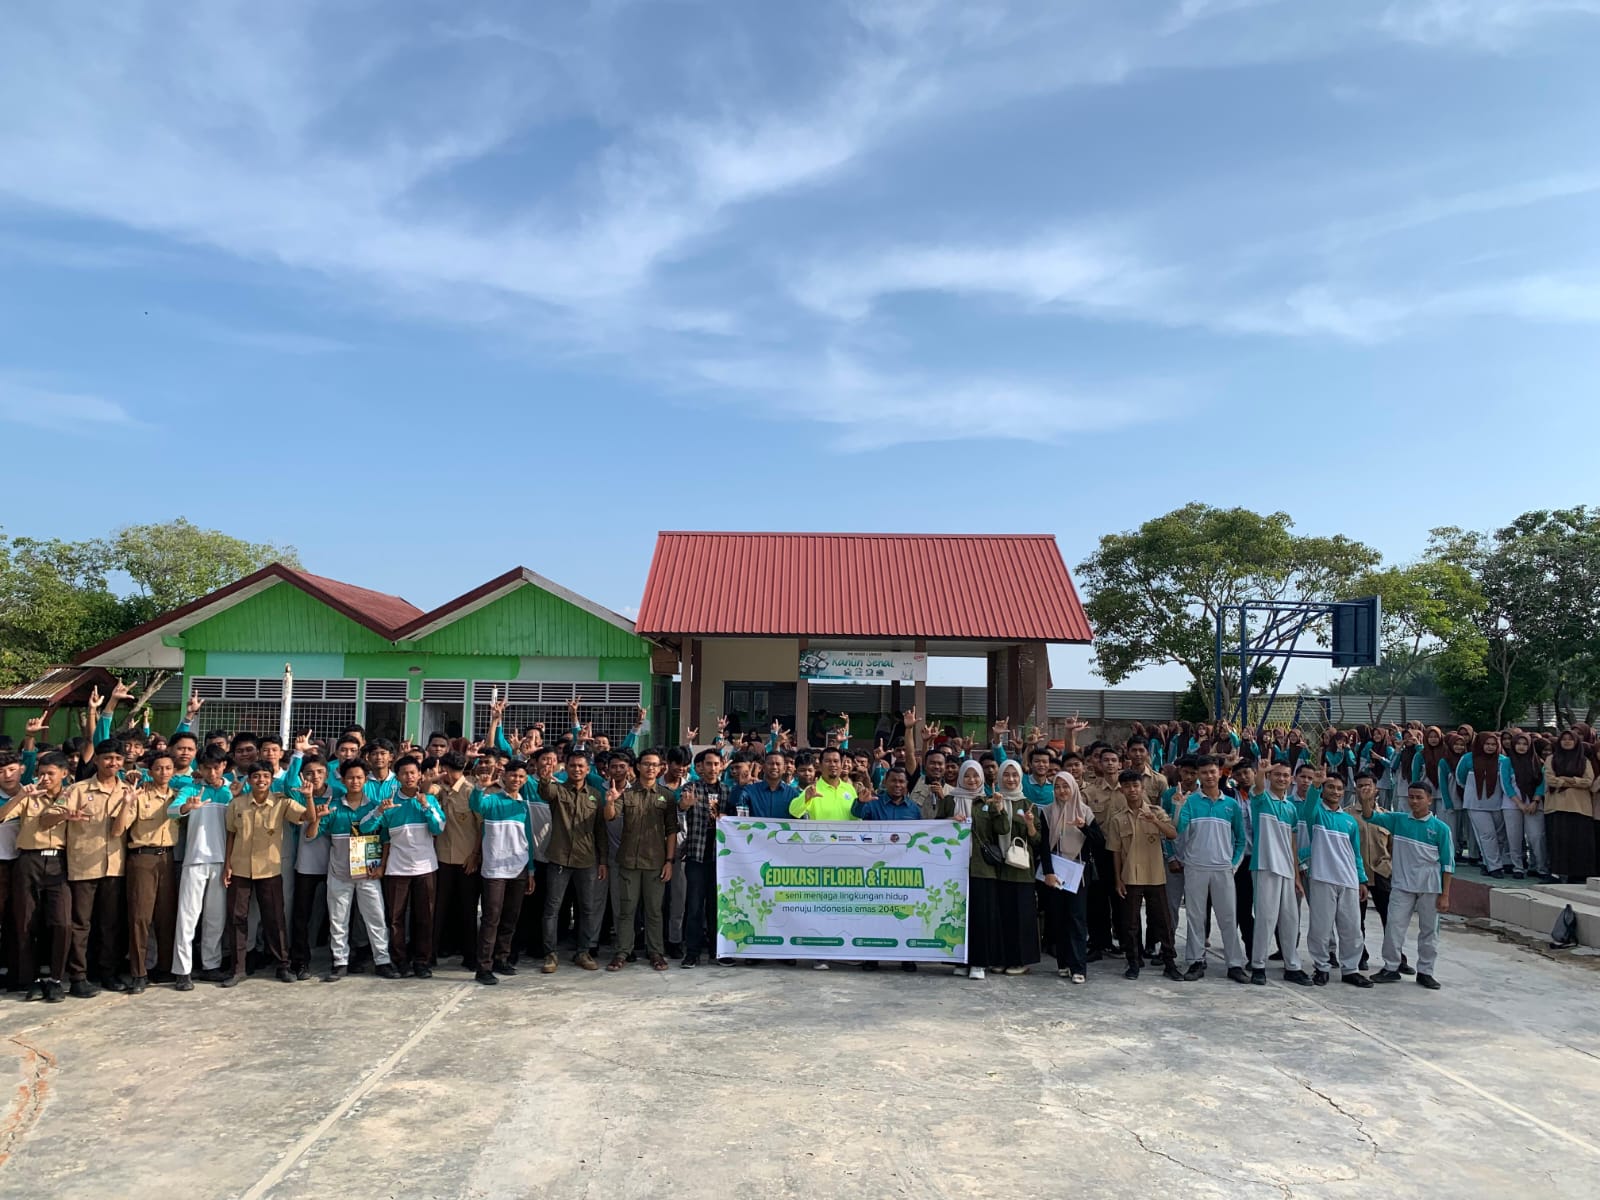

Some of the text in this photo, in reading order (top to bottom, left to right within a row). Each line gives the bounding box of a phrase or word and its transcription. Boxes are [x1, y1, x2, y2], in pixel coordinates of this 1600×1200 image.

[765, 867, 923, 887] EDUKASI FLORA & FAUNA
[785, 891, 802, 900] seni
[803, 891, 838, 901] menjaga
[839, 891, 884, 901] lingkungan
[885, 892, 909, 902] hidup
[782, 905, 812, 914] menuju
[813, 904, 853, 913] Indonesia
[878, 905, 900, 913] 2045
